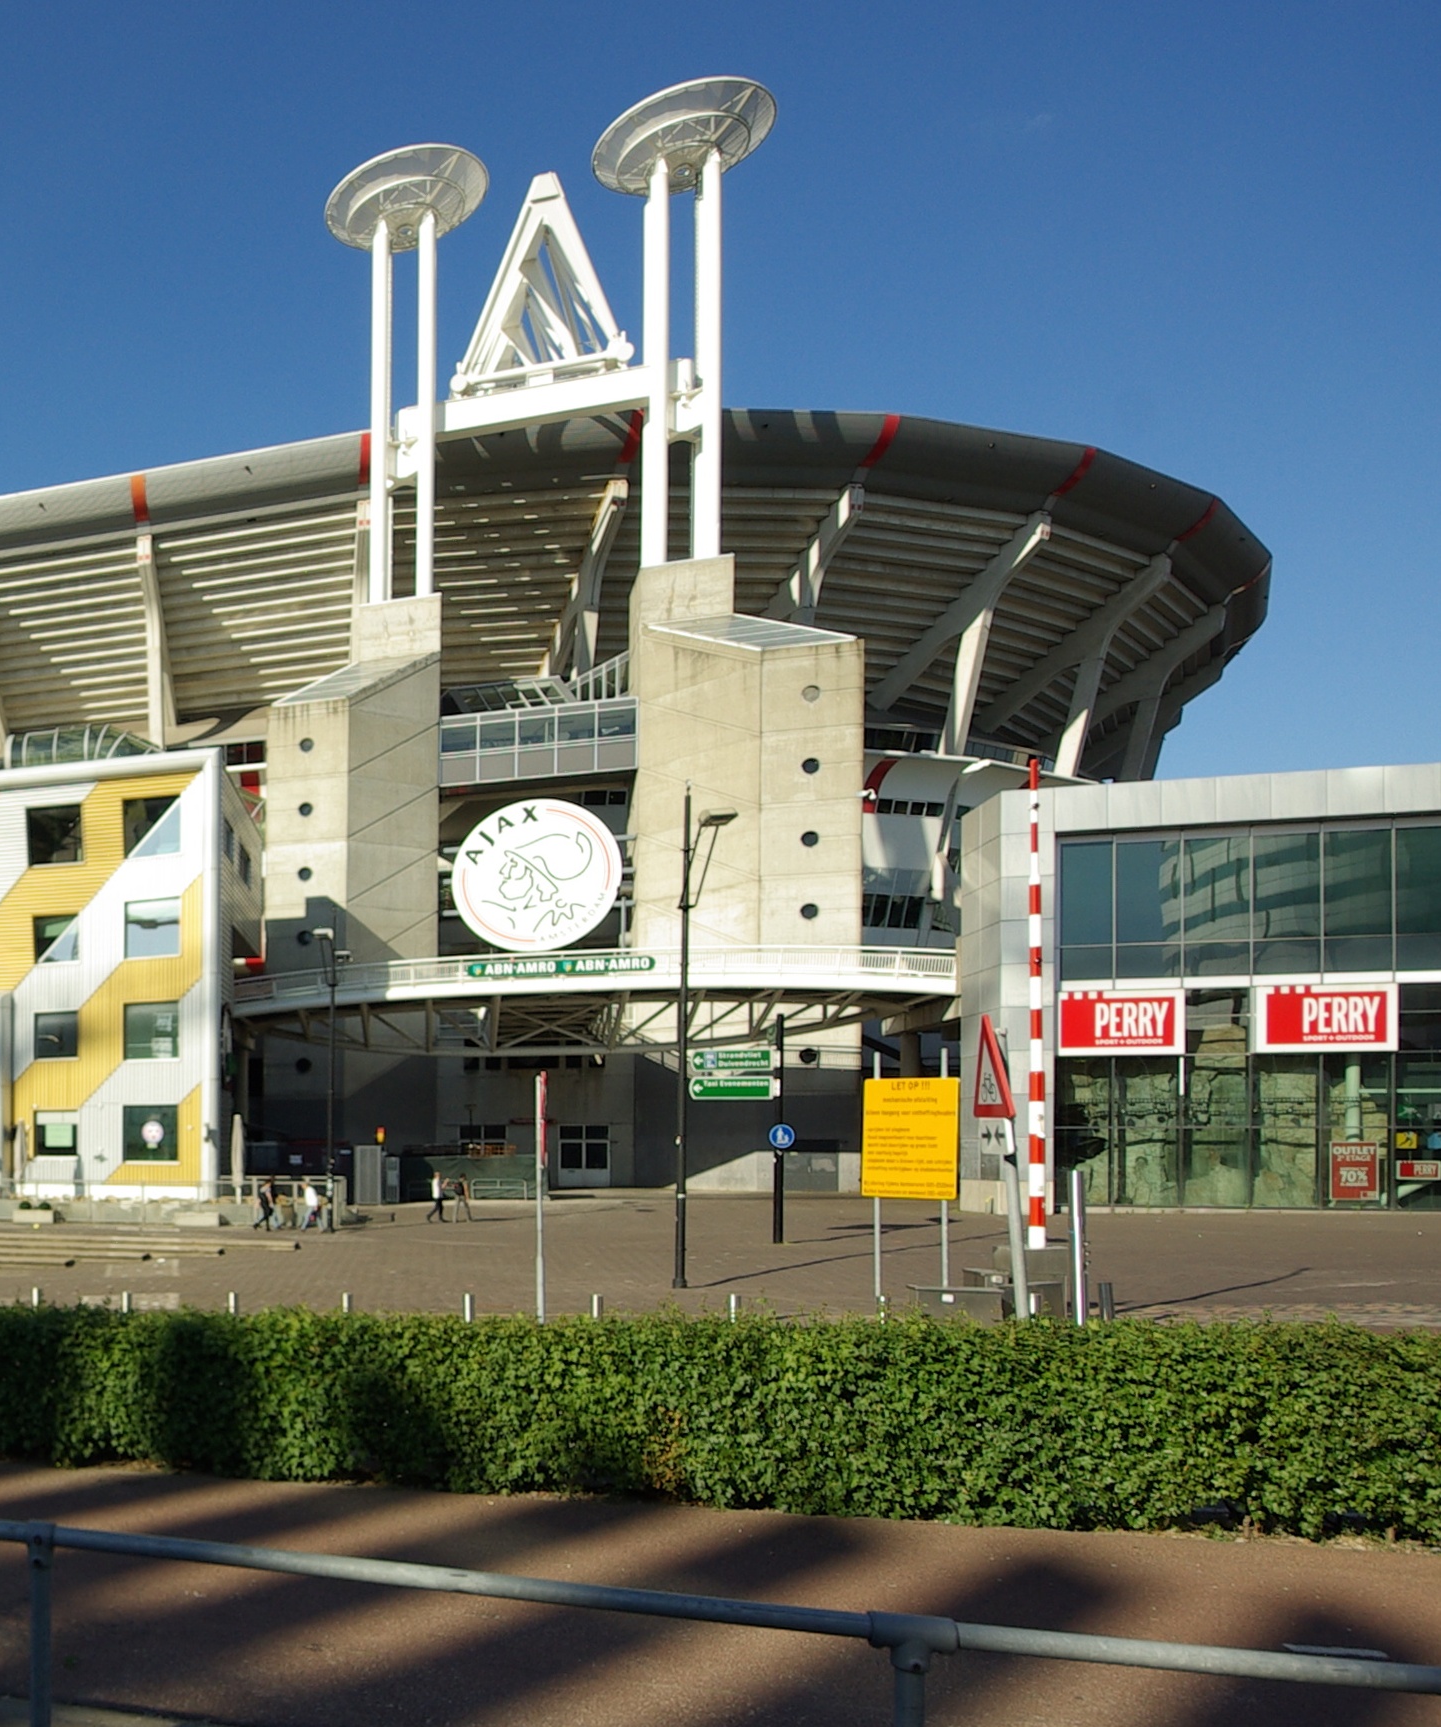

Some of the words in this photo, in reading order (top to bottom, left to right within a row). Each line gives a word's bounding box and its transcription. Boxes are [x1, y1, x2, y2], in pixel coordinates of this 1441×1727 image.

[465, 805, 539, 866] AJAX
[540, 892, 606, 942] AMSTERDAM
[1094, 1001, 1170, 1038] PERRY
[1302, 996, 1381, 1034] PERRY
[1095, 1038, 1118, 1046] SPORT
[891, 1081, 906, 1090] LET
[908, 1081, 919, 1090] OP
[1333, 1146, 1376, 1155] OUTLET
[1340, 1170, 1368, 1182] 70%
[1413, 1164, 1437, 1176] PERRY
